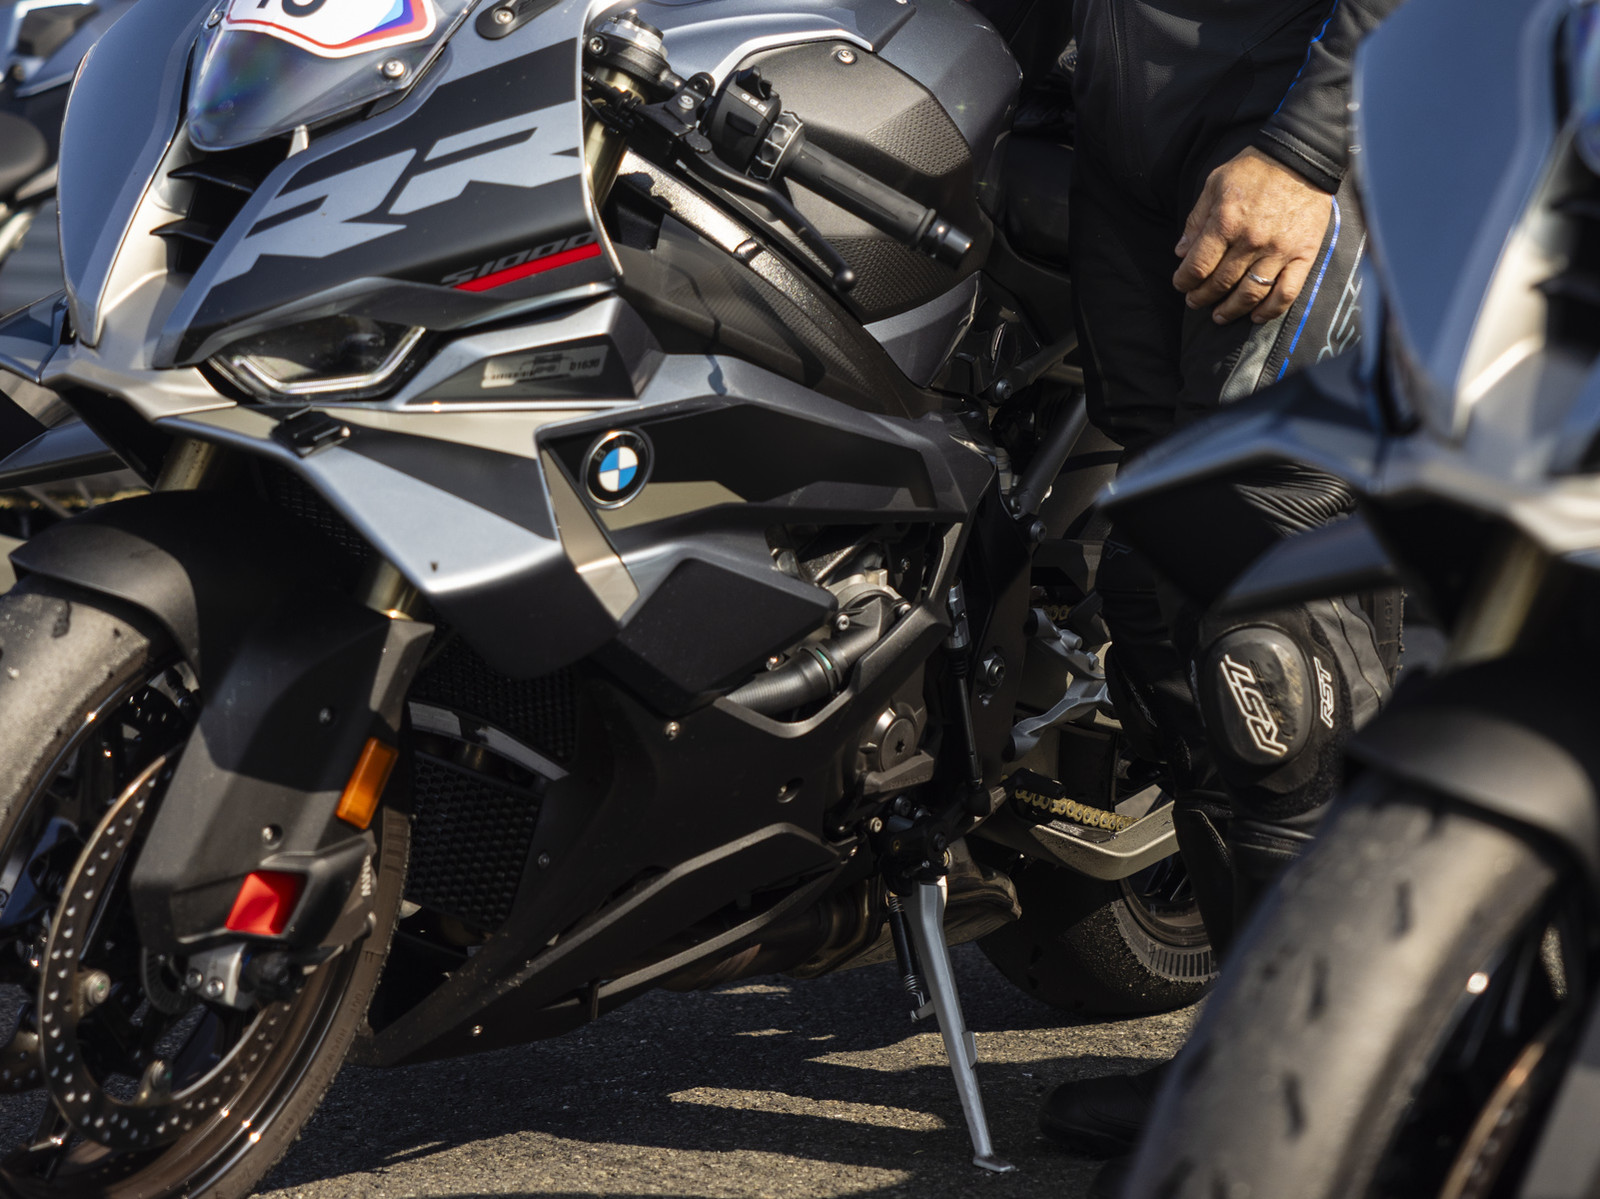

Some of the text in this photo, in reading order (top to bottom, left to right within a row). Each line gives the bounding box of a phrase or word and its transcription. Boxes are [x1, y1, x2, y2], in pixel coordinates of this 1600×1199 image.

[205, 99, 583, 292] RR
[440, 231, 598, 289] S1000
[1220, 654, 1288, 757] RST
[1313, 656, 1334, 728] RST
